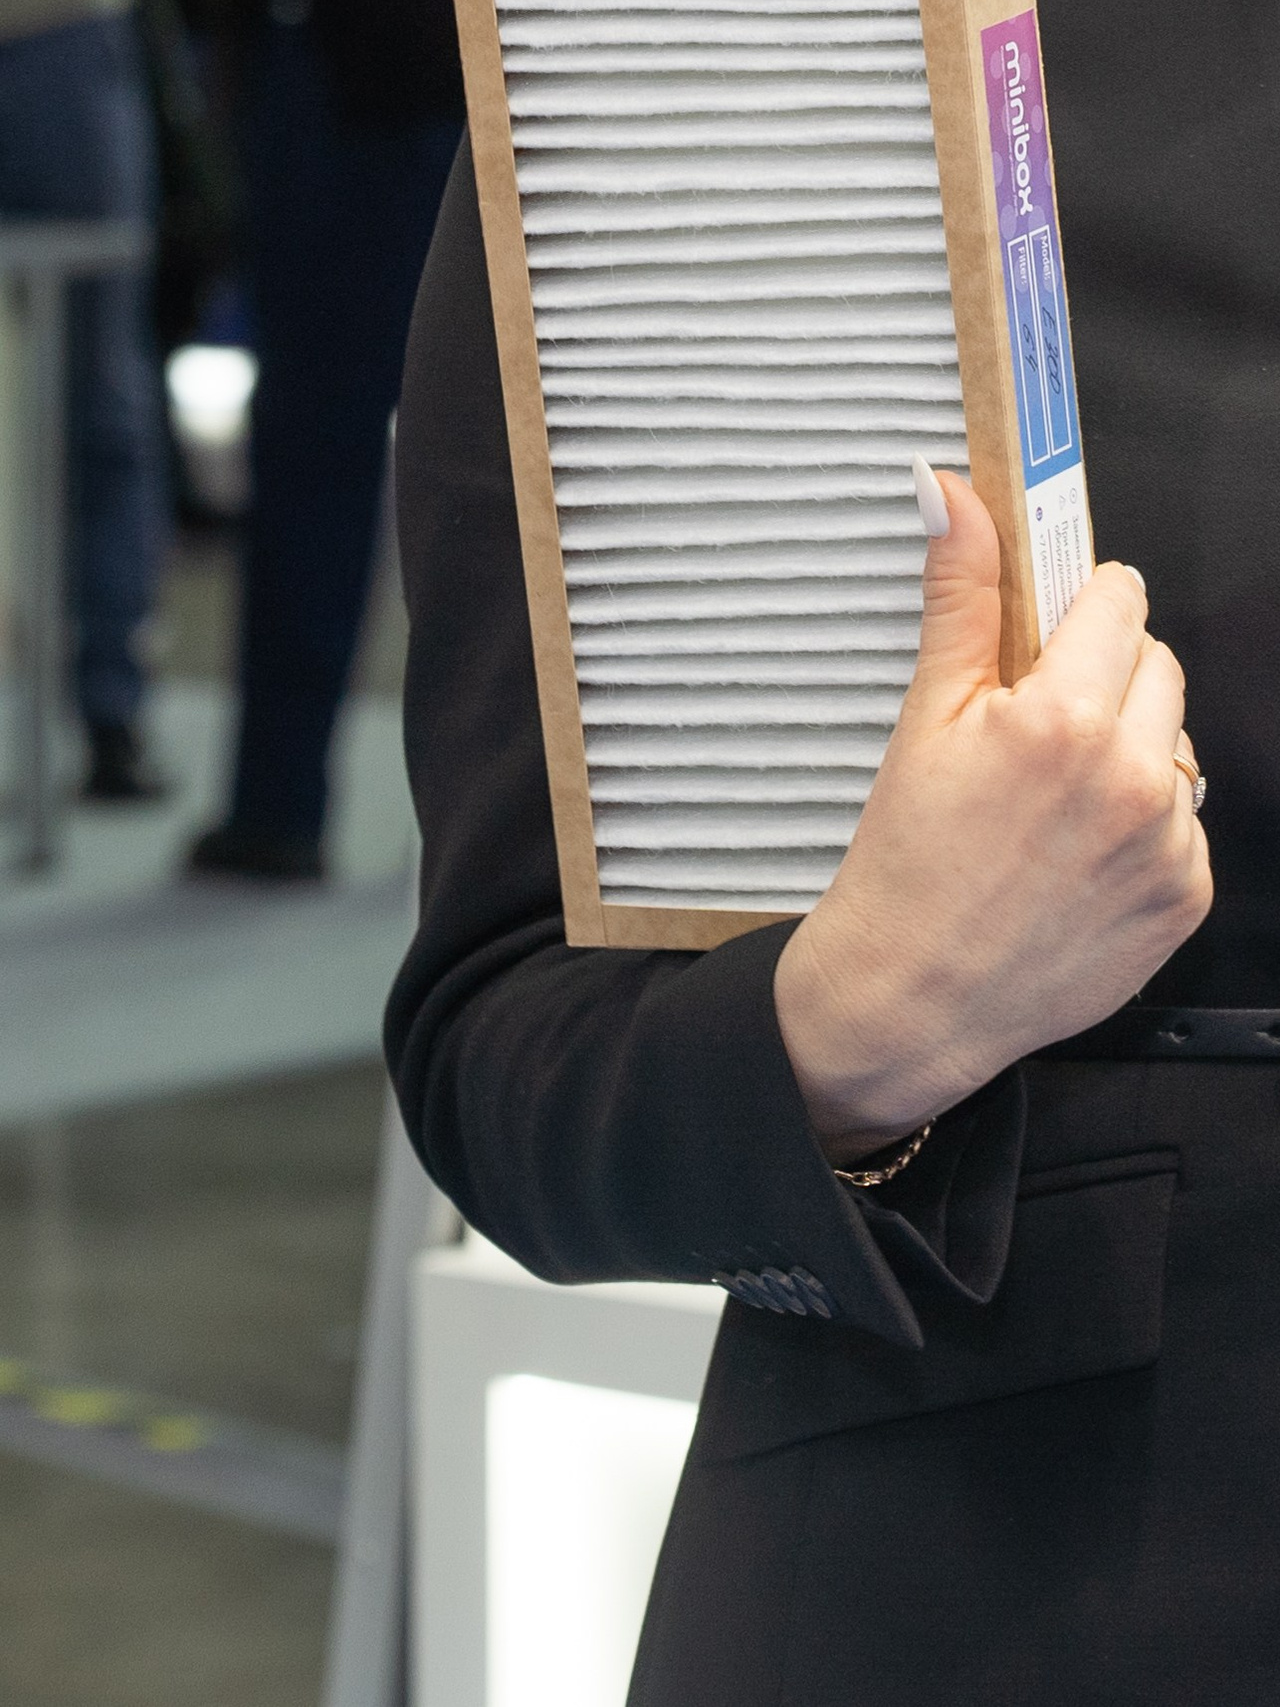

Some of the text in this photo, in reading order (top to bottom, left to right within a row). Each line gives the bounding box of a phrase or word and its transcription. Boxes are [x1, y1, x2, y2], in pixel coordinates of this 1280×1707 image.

[1005, 41, 1034, 215] minibox
[1018, 246, 1028, 286] Filter:
[1040, 235, 1051, 282] Model:
